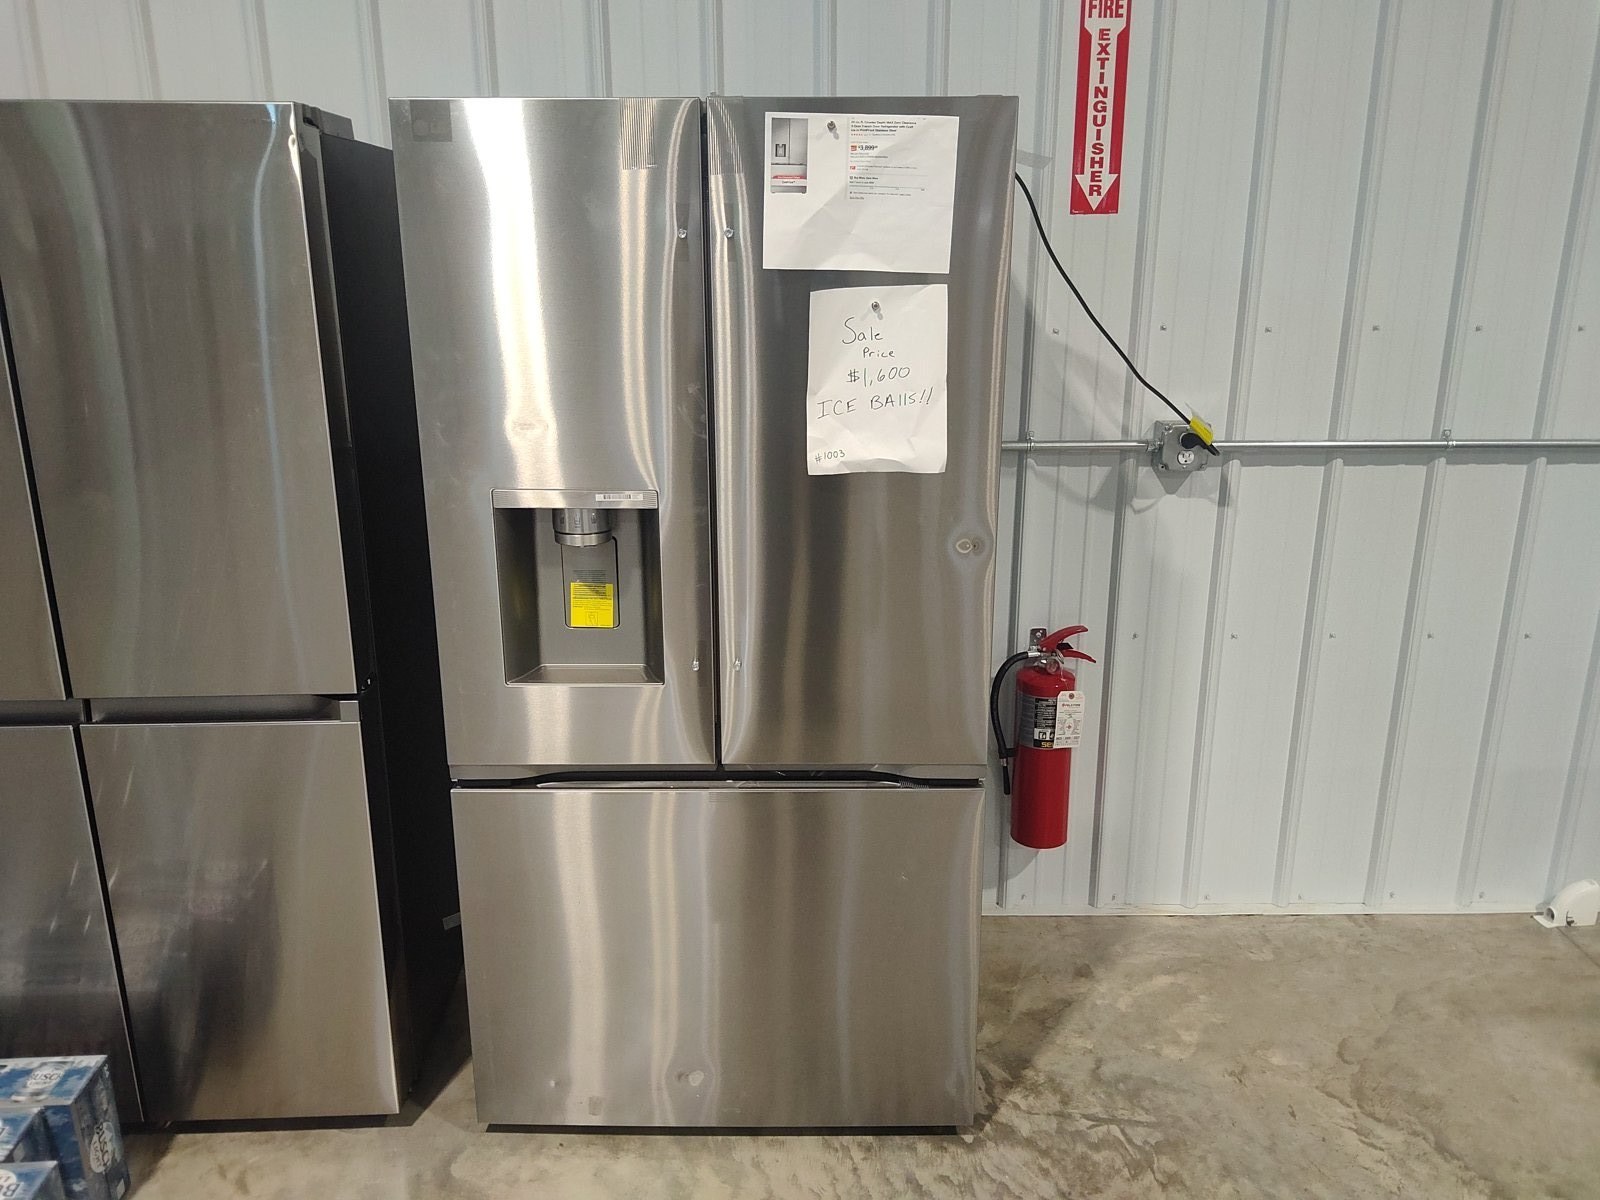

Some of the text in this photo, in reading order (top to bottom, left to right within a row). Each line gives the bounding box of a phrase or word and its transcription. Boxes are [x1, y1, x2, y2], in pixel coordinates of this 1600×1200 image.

[1088, 0, 1124, 18] FIRE
[1088, 28, 1111, 197] EXTINGUISHER
[842, 317, 884, 345] Sale
[862, 346, 895, 359] Price
[846, 366, 911, 388] $1,600
[817, 398, 857, 419] ICE
[814, 449, 846, 463] #1003
